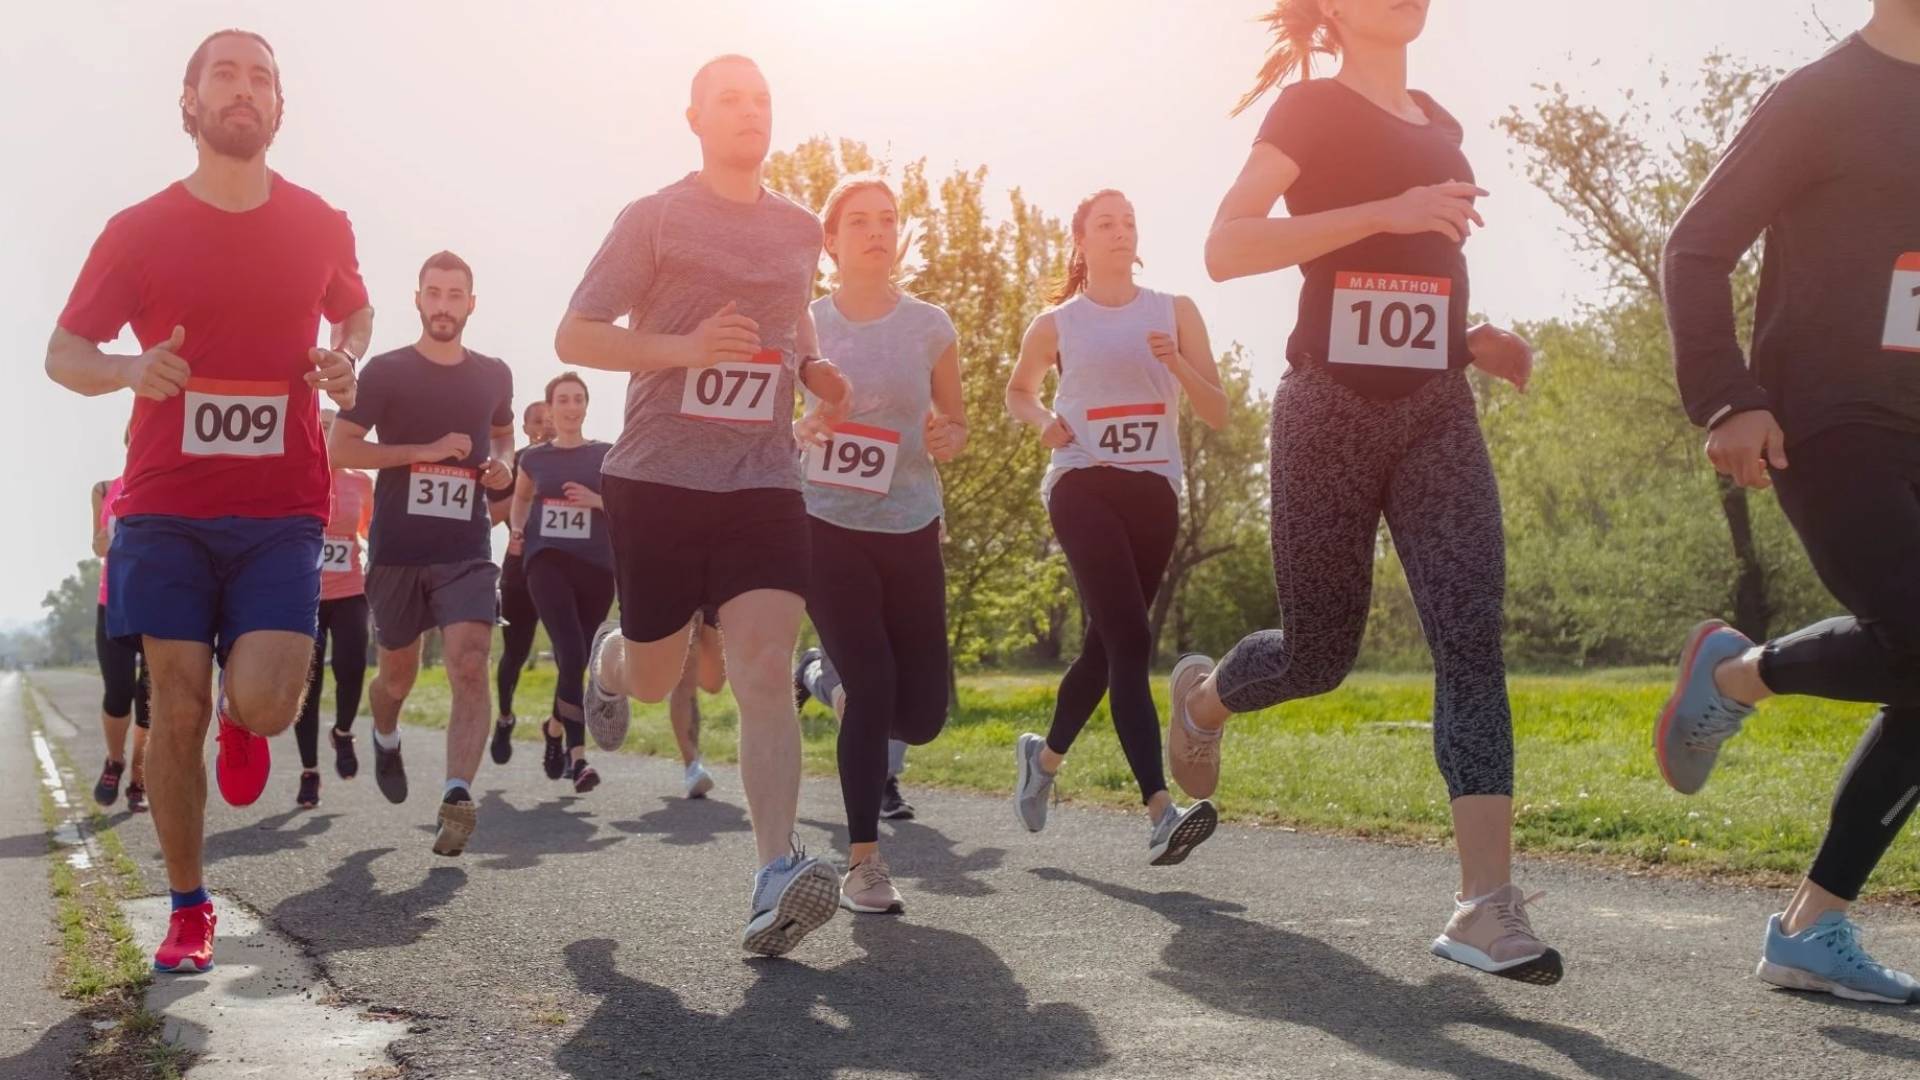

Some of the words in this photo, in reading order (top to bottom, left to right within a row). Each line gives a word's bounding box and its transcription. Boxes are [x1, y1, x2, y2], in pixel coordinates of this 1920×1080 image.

[1350, 277, 1438, 293] MARATHON
[1351, 301, 1436, 350] 102
[696, 368, 771, 408] 077
[195, 402, 278, 444] 009
[1099, 422, 1159, 454] 457
[822, 440, 885, 478] 199
[416, 479, 467, 509] 314
[545, 510, 585, 530] 214
